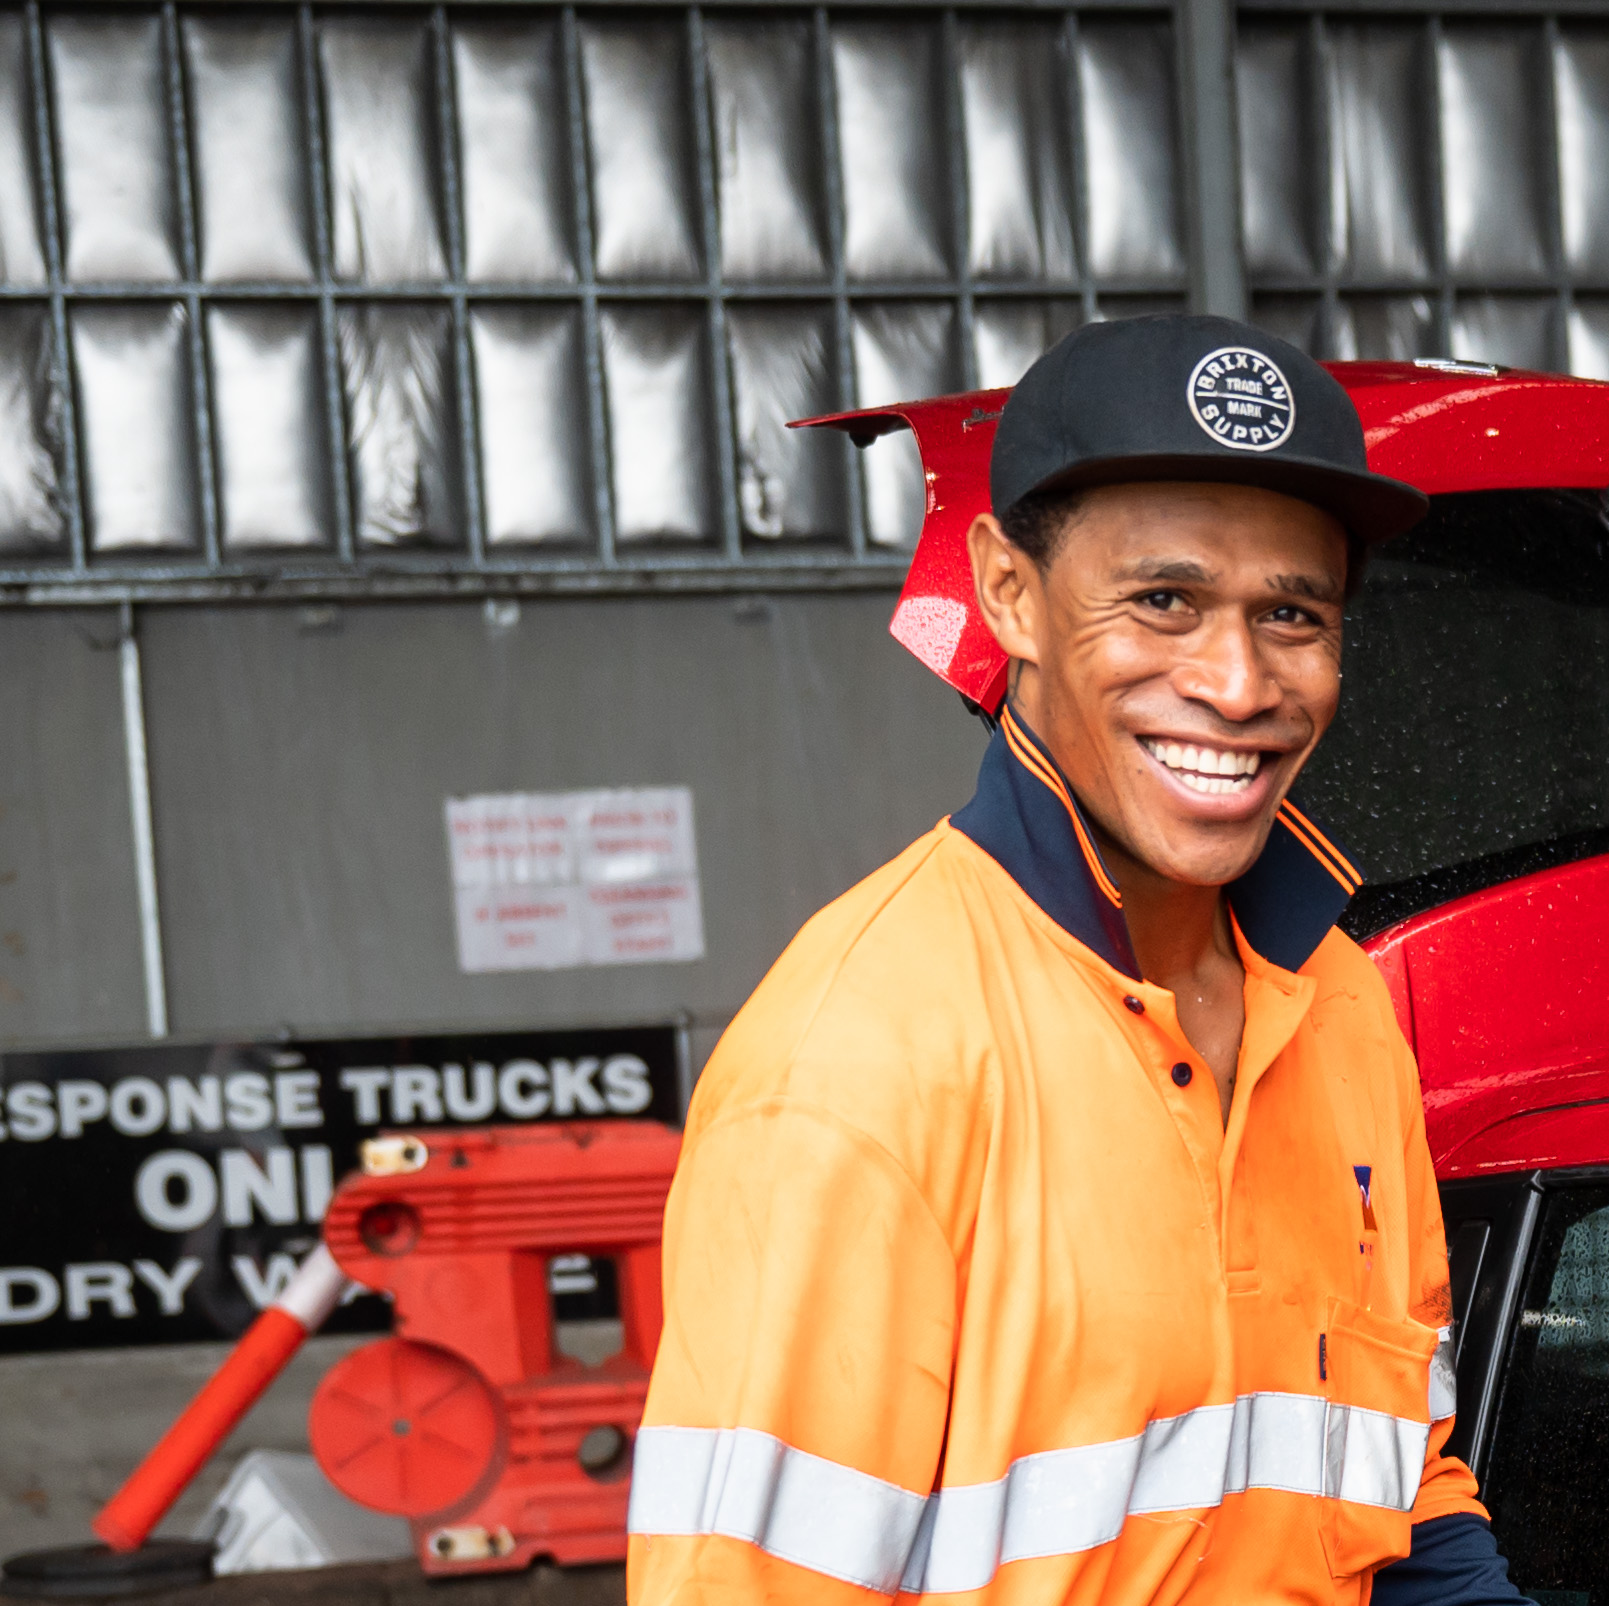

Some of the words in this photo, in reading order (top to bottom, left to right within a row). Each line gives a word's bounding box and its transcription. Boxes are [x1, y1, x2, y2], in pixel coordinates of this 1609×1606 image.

[1197, 354, 1286, 399] BRIXTON
[1226, 378, 1263, 395] TRADE
[1200, 404, 1285, 444] SUPPLY
[1227, 401, 1262, 418] MARK
[0, 1070, 324, 1142] SPONSE
[339, 1053, 653, 1125] TRUCKS
